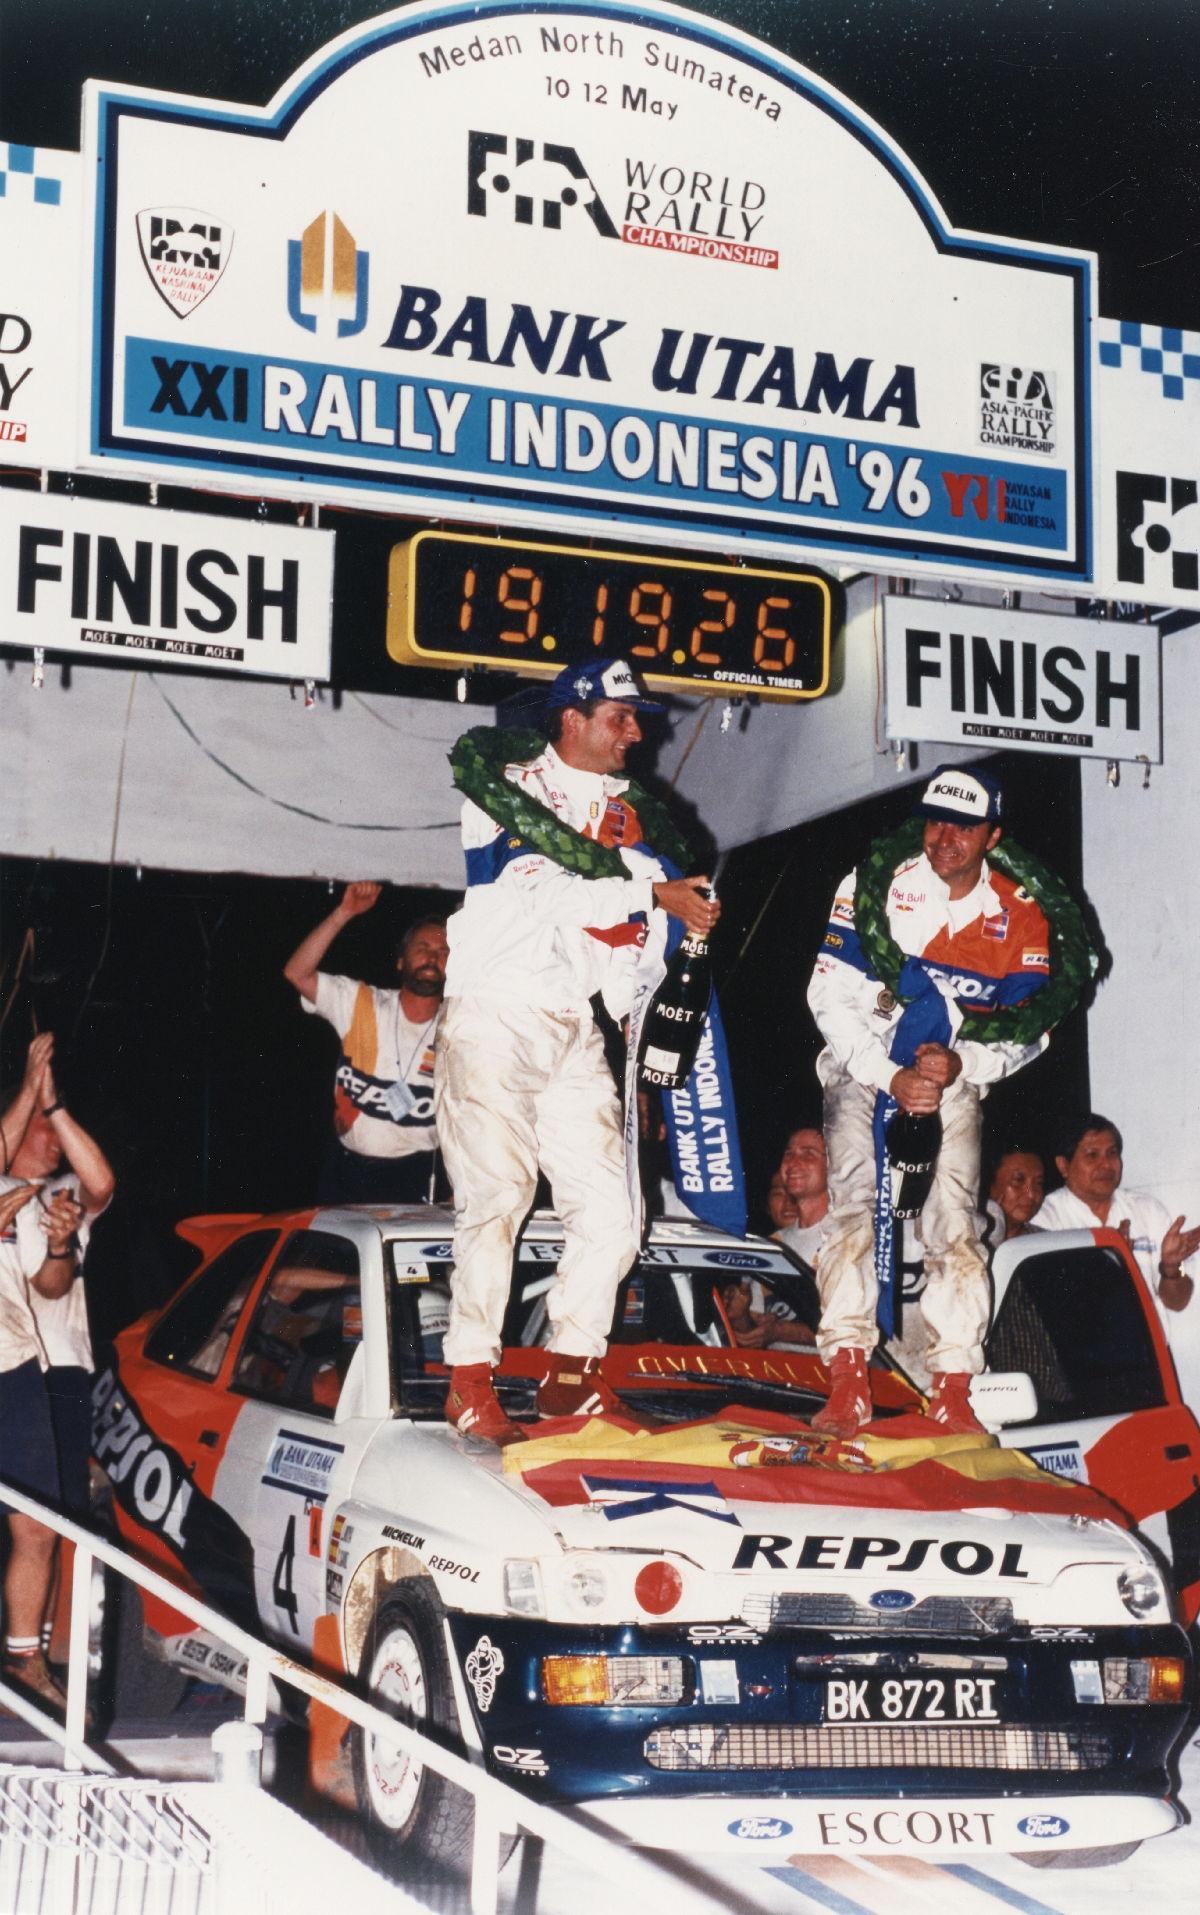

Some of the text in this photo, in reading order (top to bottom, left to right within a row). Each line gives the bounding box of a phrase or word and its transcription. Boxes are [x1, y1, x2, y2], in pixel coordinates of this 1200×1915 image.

[419, 27, 782, 121] Medan North Sumatera
[546, 77, 678, 120] 10 12 May
[625, 158, 766, 210] WORLD
[624, 192, 764, 242] RALLY
[625, 227, 777, 267] CHAMPIONSHIP
[382, 284, 920, 428] BANK UTAMA
[150, 355, 931, 518] XXI RALLY INDONESIA '96
[980, 432, 1055, 453] CHAMPIONSHIP
[981, 413, 1053, 440] RALLY
[1005, 481, 1052, 499] YAYASAN
[1005, 496, 1035, 512] RALLY
[1005, 513, 1056, 531] INDONESIA
[17, 525, 299, 643] FINISH
[713, 671, 764, 685] OFFICIAL
[767, 677, 803, 689] TIMER
[906, 628, 1140, 731] FINISH
[891, 888, 926, 903] Red Bull
[677, 1131, 704, 1193] BANK
[701, 1115, 734, 1192] RALLY
[719, 1250, 759, 1267] Ford
[92, 1369, 193, 1549] REPSOL
[284, 1445, 336, 1473] BANK UTAMA
[381, 1525, 426, 1550] MICHELIN
[731, 1534, 1029, 1578] REPSOL
[273, 1515, 300, 1636] 4
[428, 1555, 480, 1583] REPSOL
[827, 1679, 998, 1720] BK 872 RI
[737, 1816, 783, 1839] Ford
[817, 1811, 996, 1846] ESCORT
[1024, 1814, 1063, 1837] Ford
